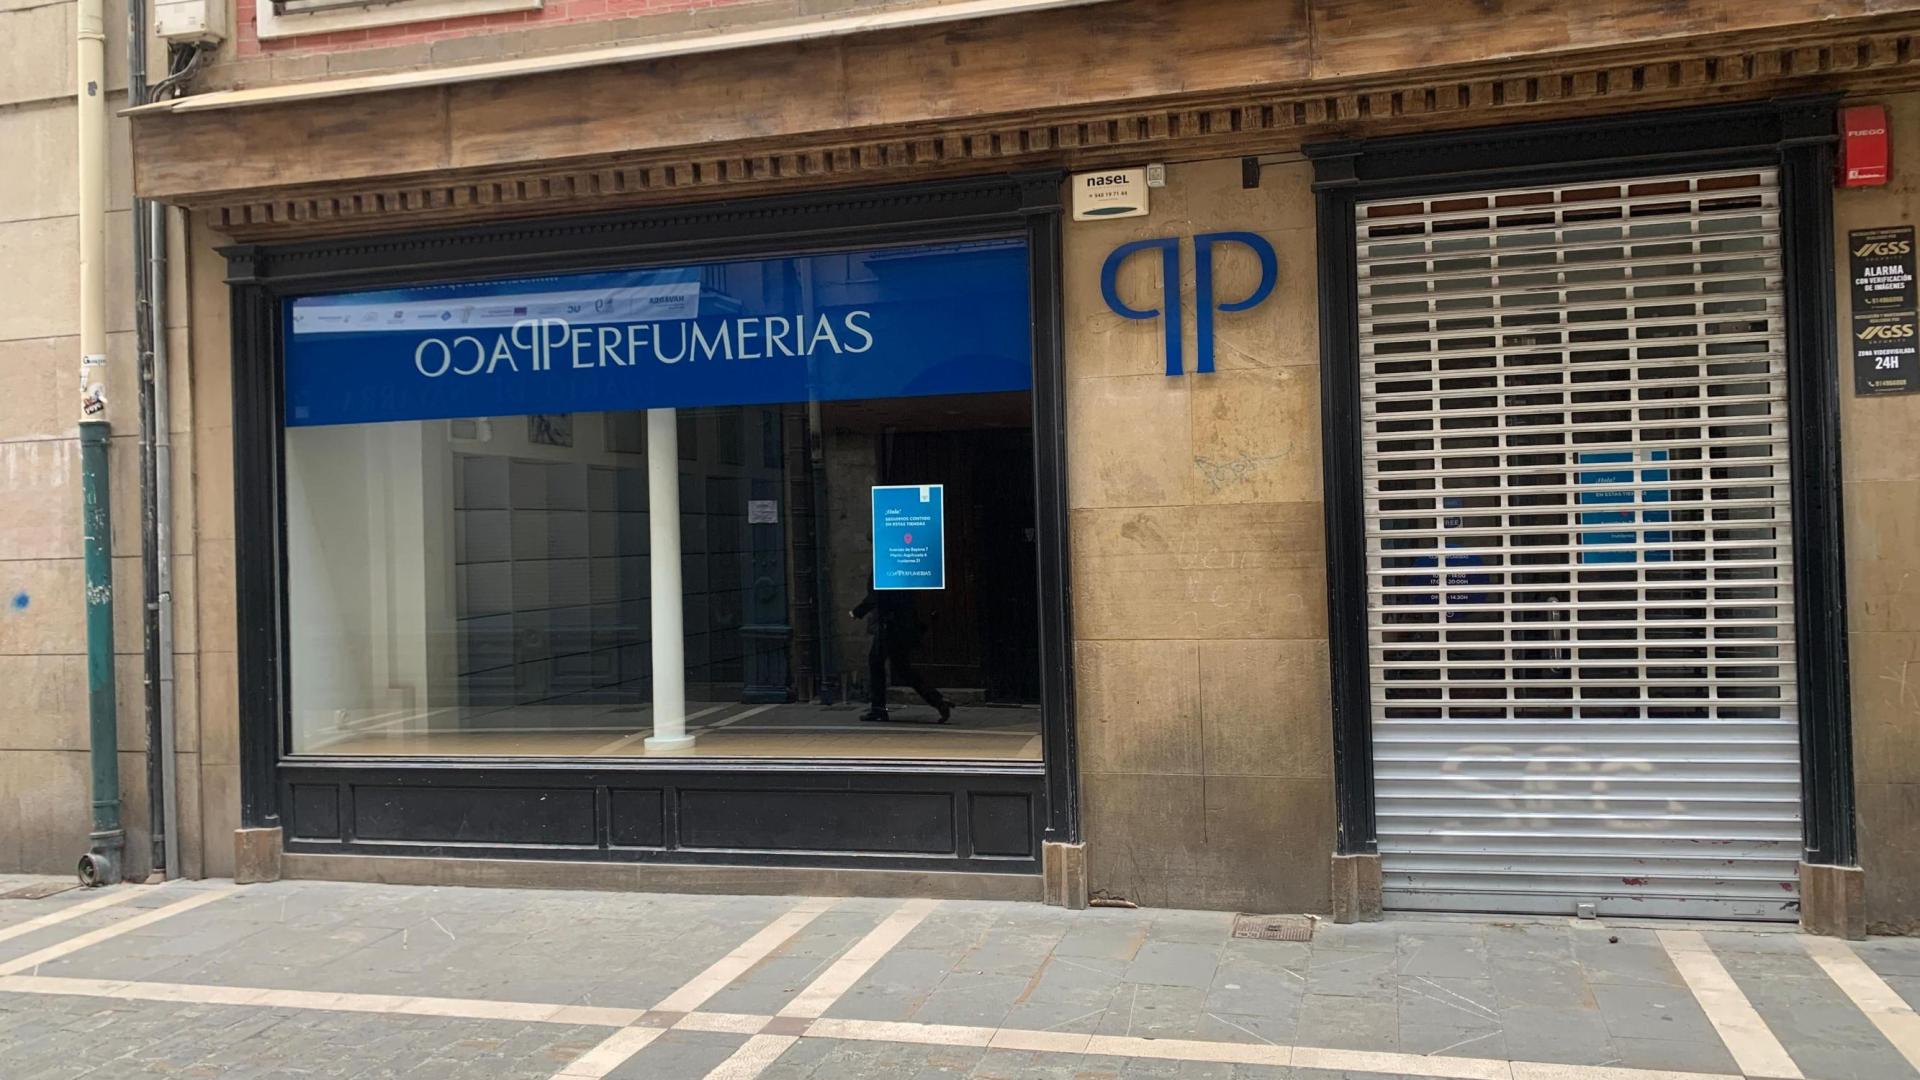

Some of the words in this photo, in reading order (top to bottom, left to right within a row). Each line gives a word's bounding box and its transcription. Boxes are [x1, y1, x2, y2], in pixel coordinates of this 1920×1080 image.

[1848, 128, 1885, 137] FUEGO
[1874, 240, 1911, 256] GSS
[1864, 265, 1904, 277] ALARMA
[1877, 323, 1914, 339] GSS
[1875, 356, 1899, 370] 24H
